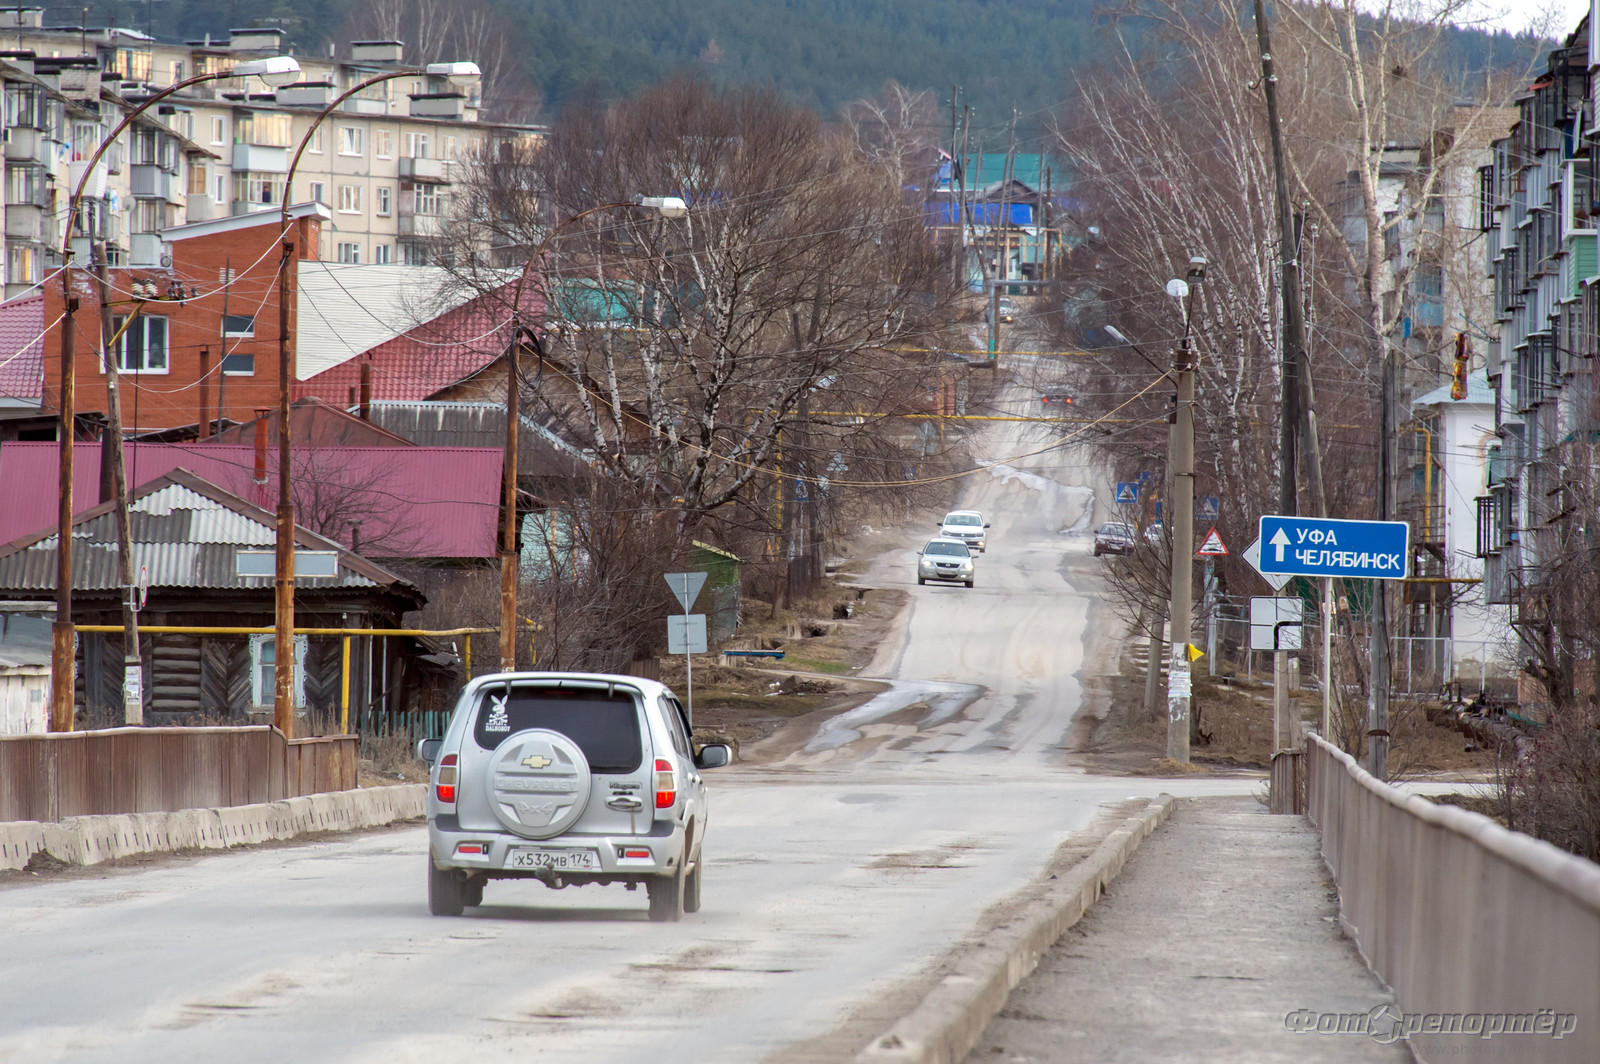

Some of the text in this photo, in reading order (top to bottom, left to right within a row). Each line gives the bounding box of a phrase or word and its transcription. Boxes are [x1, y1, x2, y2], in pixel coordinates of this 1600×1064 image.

[1296, 527, 1338, 546] УФА
[1295, 549, 1401, 570] ЧЕЛЯБИНСК
[495, 778, 577, 791] CHEVROLET
[570, 854, 591, 864] 174
